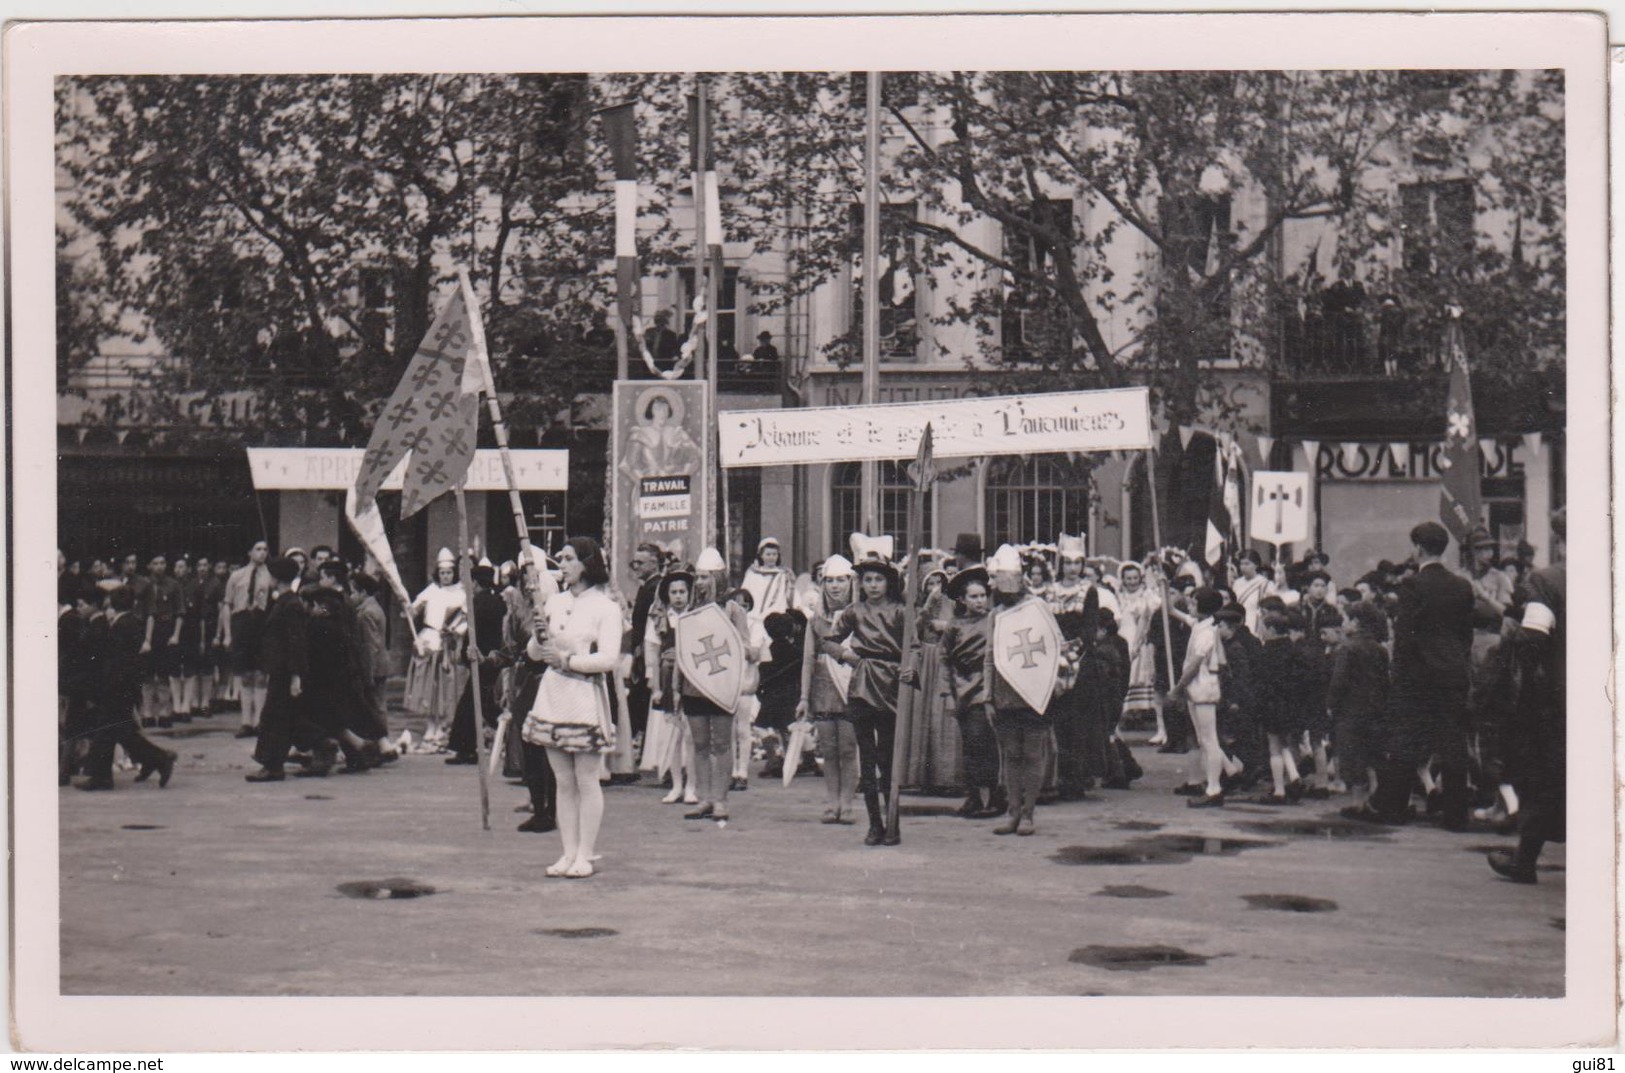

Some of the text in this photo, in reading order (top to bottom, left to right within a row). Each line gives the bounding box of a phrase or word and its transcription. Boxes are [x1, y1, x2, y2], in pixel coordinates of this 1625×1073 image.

[643, 480, 687, 493] TRAVAIL
[643, 499, 687, 512] FAMILLE
[643, 519, 689, 533] PATRIE
